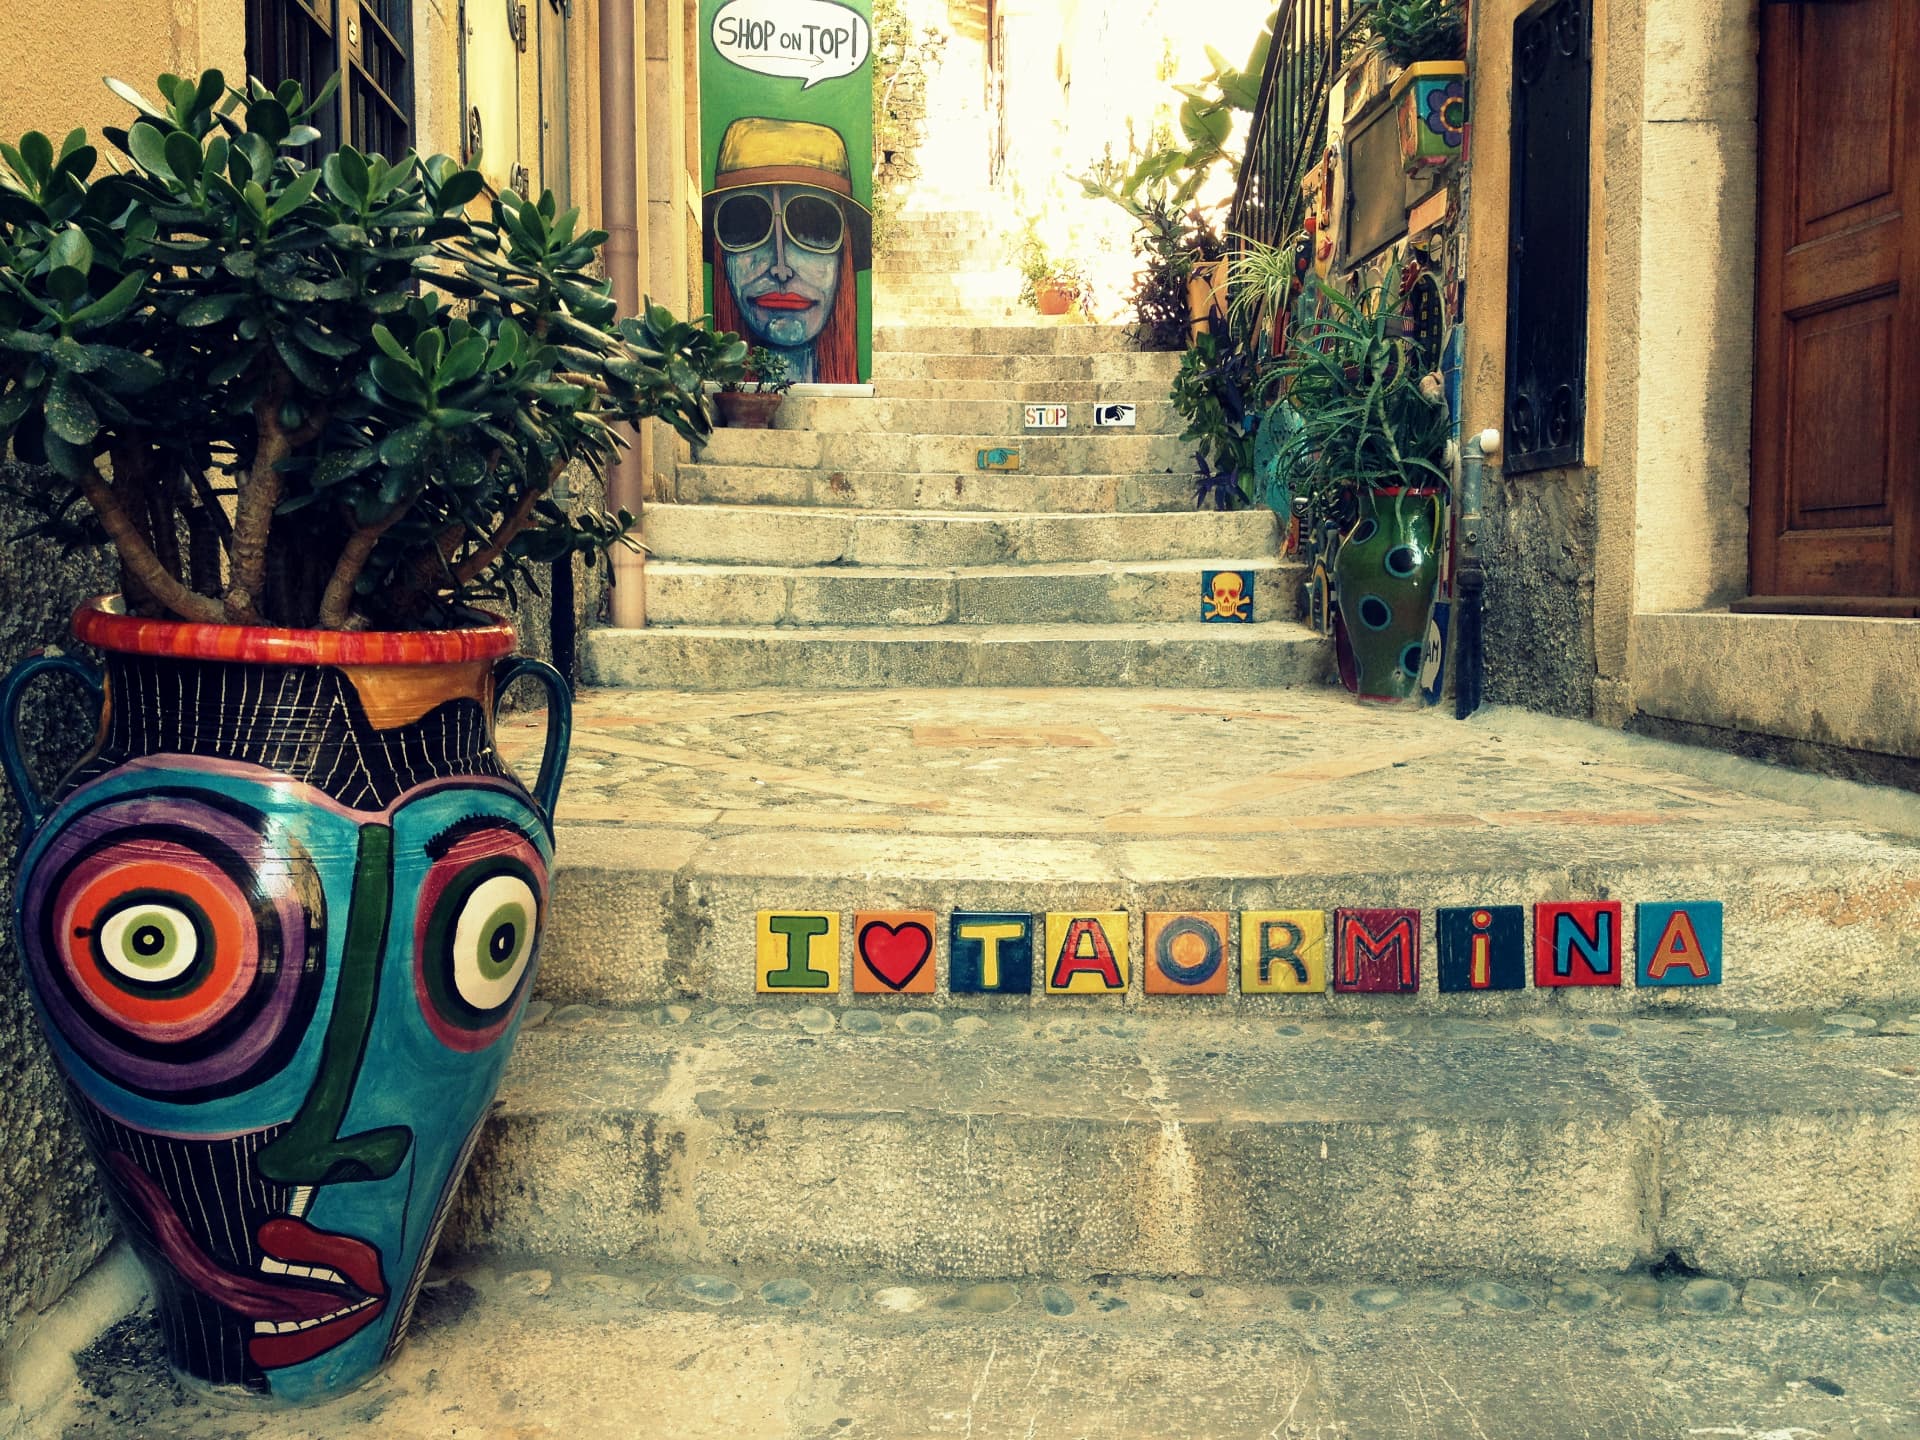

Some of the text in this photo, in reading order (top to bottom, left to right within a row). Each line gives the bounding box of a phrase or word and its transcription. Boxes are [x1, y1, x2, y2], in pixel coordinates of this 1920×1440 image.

[719, 17, 857, 66] SHOP ON TOP!
[1026, 407, 1066, 425] STOP
[766, 915, 829, 988] I
